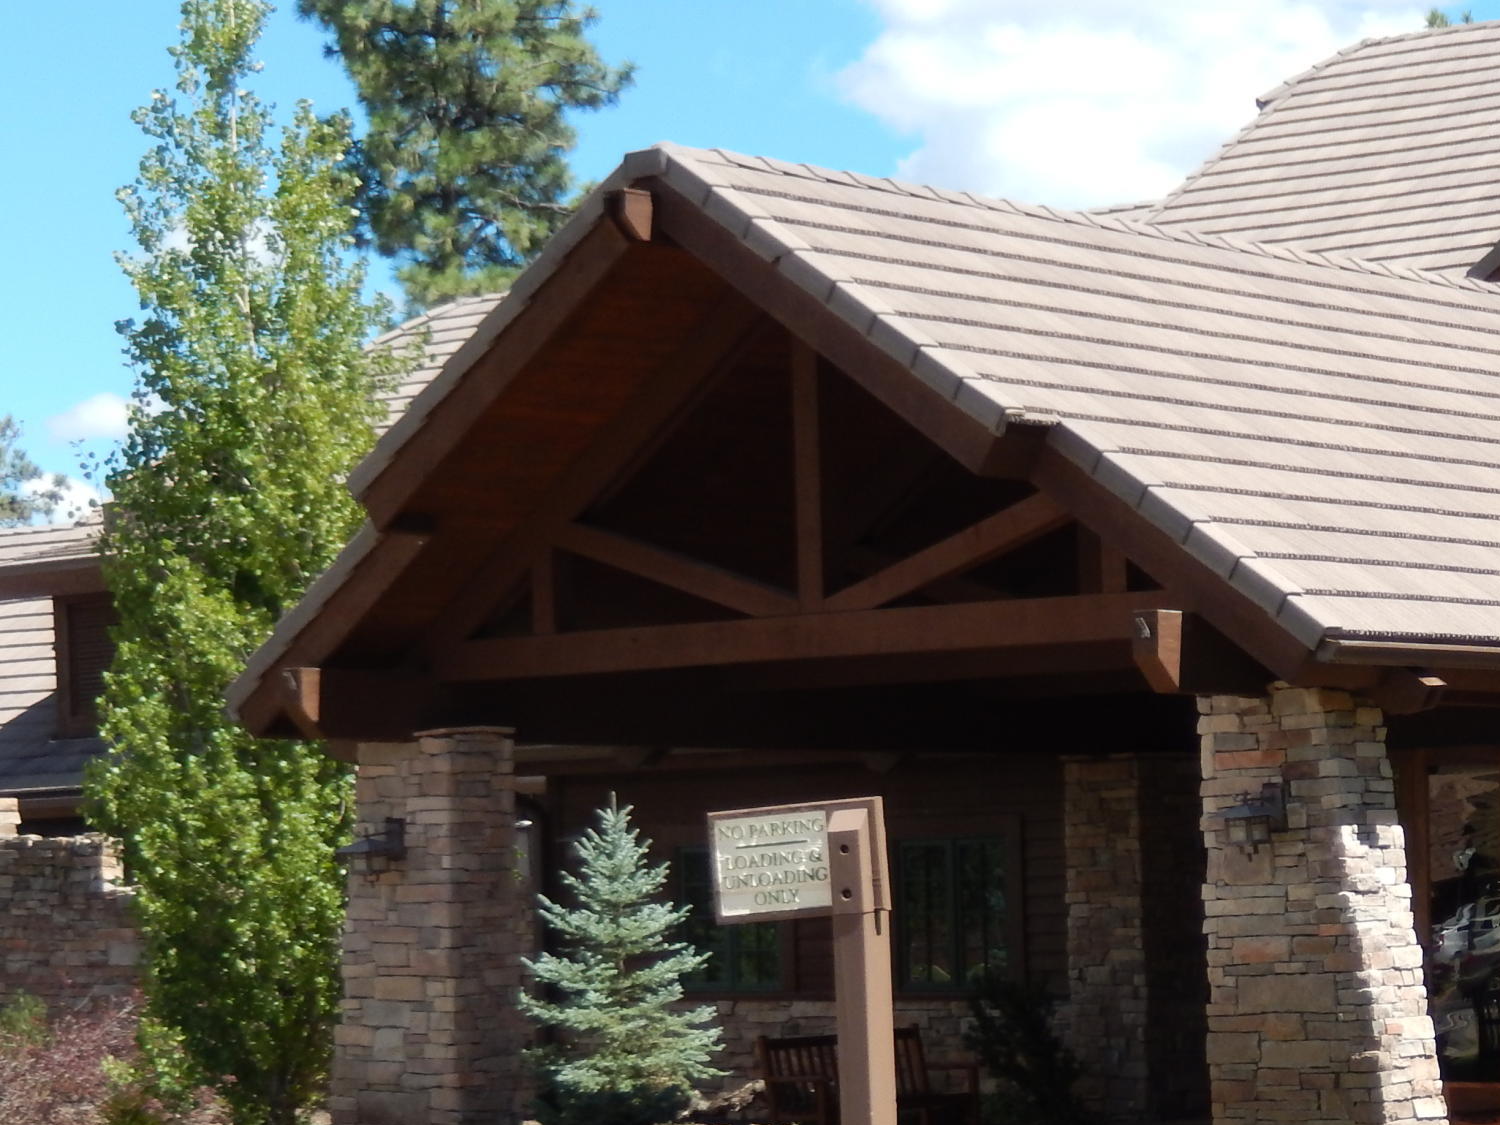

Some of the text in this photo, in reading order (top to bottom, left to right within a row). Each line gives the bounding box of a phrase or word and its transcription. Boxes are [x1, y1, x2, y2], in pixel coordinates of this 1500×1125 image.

[718, 818, 825, 841] NO PARKING
[726, 847, 824, 871] LOADING &
[723, 867, 828, 890] UNLOADING
[754, 888, 800, 906] ONLY
